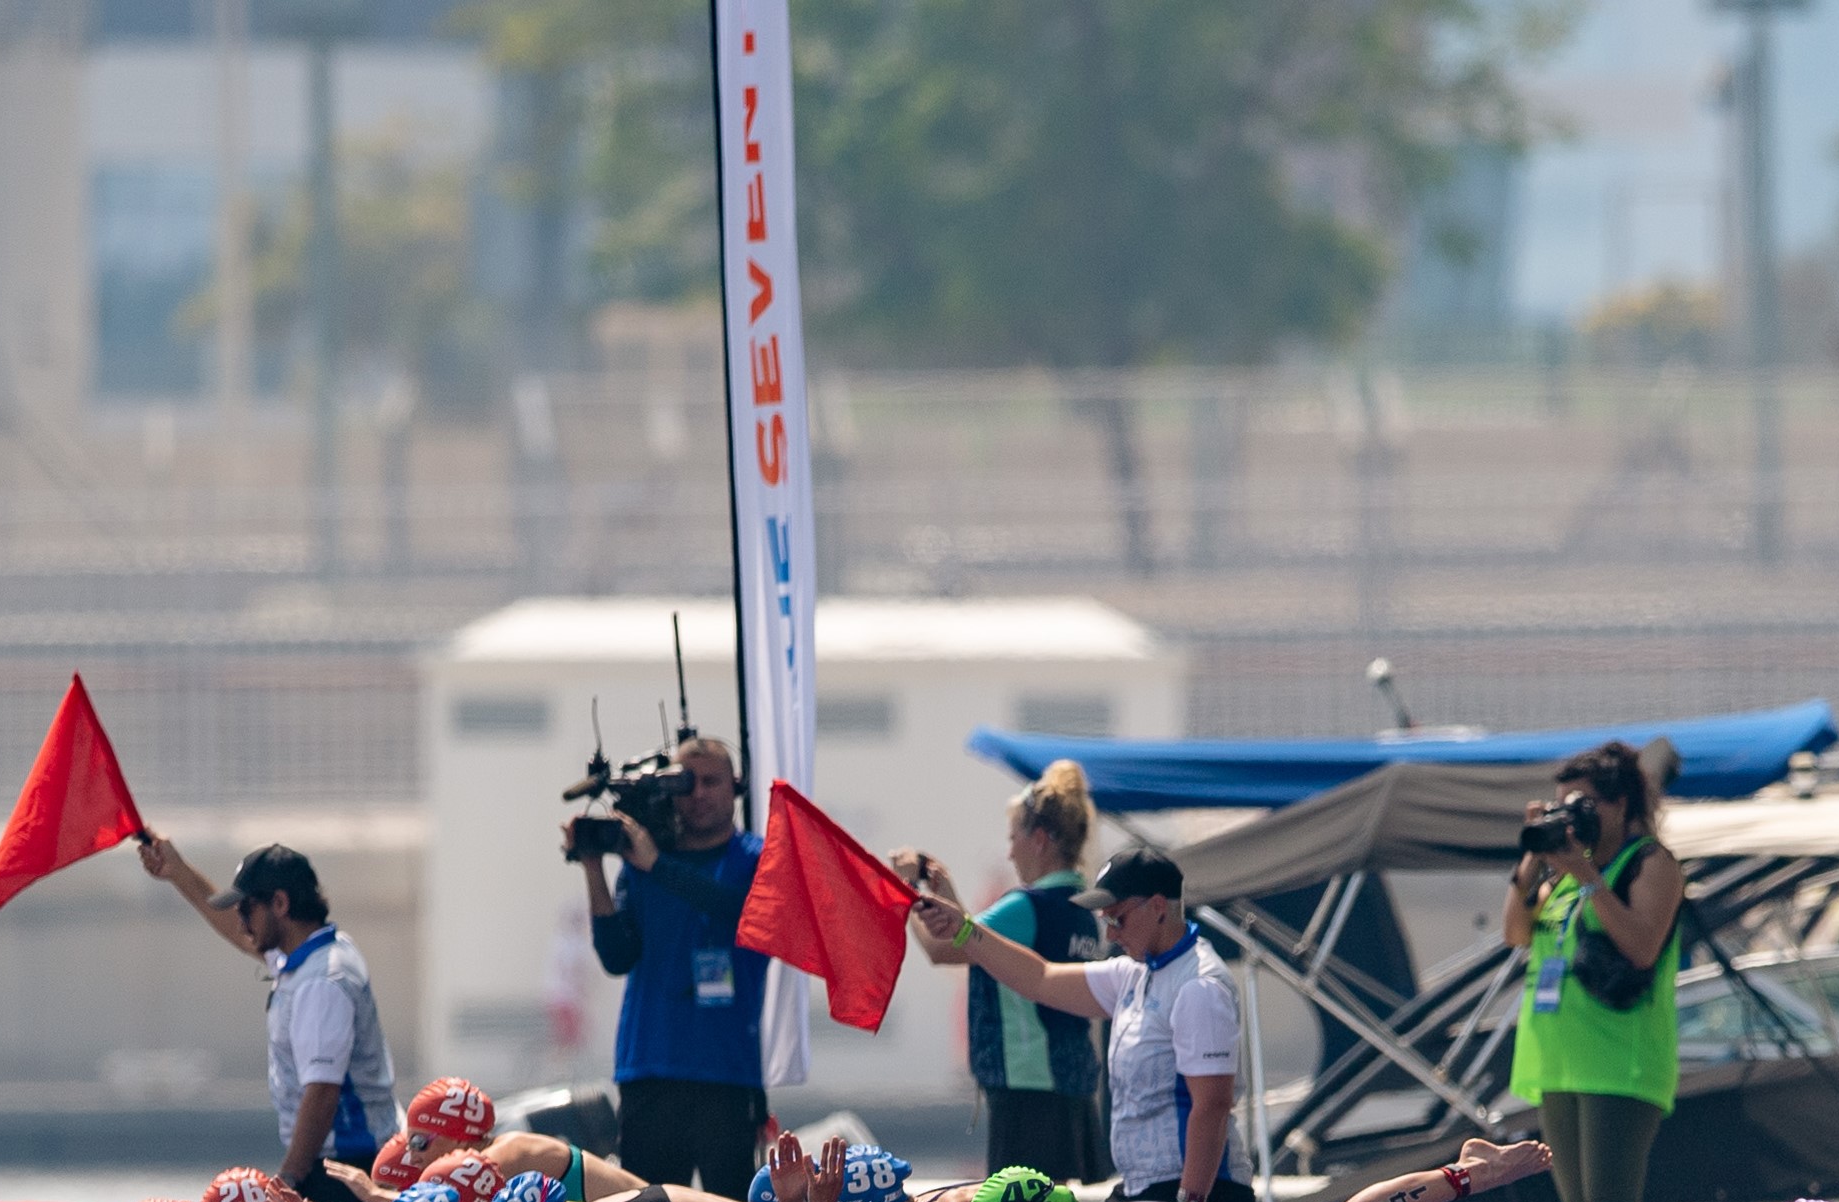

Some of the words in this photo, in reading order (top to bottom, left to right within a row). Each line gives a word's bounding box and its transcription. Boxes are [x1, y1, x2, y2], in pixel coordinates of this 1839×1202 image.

[439, 1087, 485, 1124] 29
[449, 1157, 497, 1196] 28
[847, 1158, 896, 1195] 38
